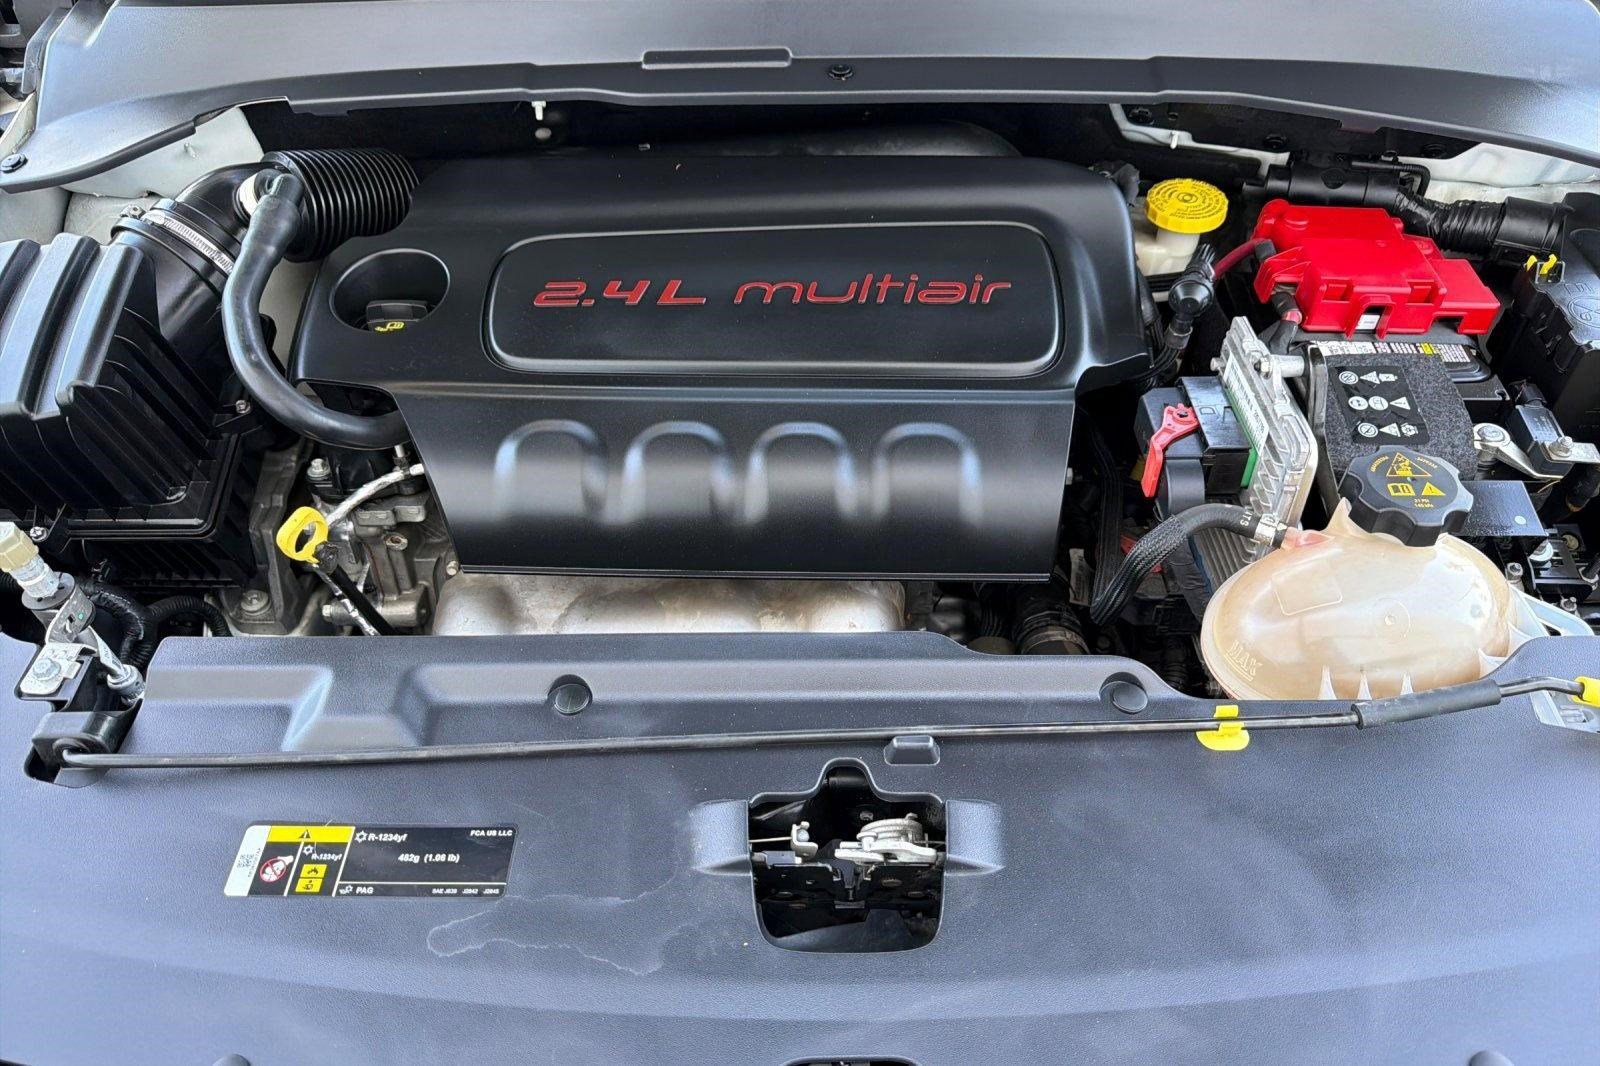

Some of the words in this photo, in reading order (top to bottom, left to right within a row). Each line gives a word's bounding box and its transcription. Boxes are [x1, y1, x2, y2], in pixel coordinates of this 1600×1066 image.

[733, 272, 1012, 305] multiair
[1224, 639, 1263, 676] MAX
[367, 832, 408, 842] R-1234yf
[469, 829, 486, 837] FCA
[486, 829, 497, 837] US
[498, 829, 513, 837] LLC
[311, 853, 342, 862] R-1234yf
[424, 853, 446, 863] (1.06
[447, 853, 460, 863] lb)
[355, 886, 374, 894] PAG
